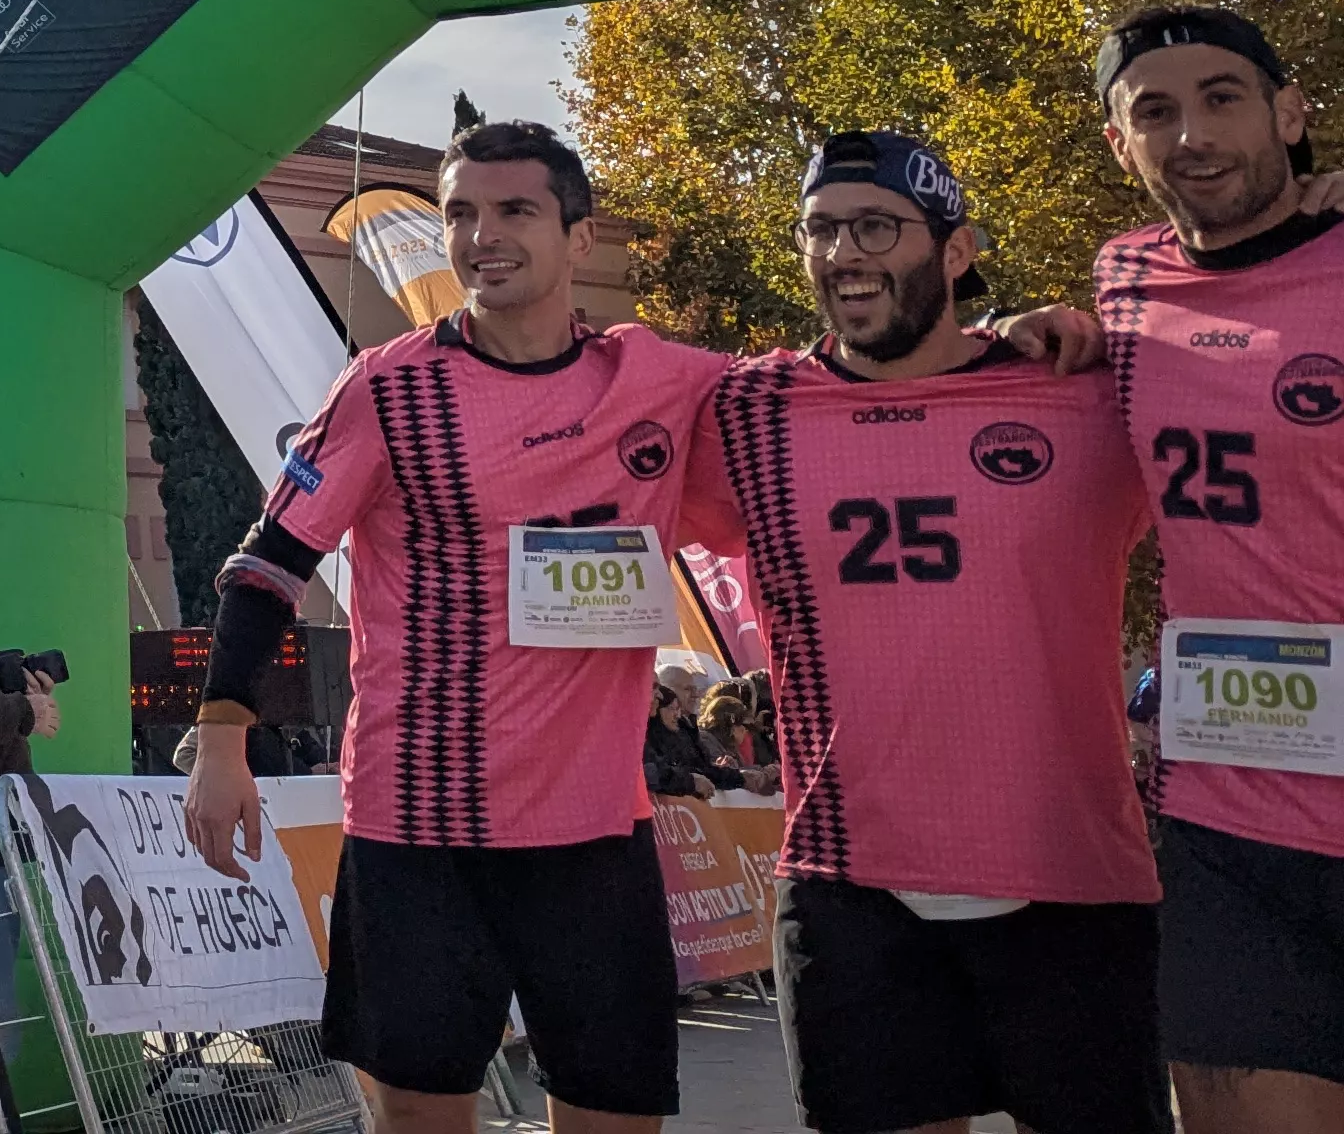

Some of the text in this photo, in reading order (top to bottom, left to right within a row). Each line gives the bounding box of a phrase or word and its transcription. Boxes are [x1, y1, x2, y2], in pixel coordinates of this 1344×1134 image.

[1189, 329, 1253, 350] adidas
[852, 404, 926, 425] adidas
[522, 421, 584, 450] adidas
[1152, 427, 1261, 528] 25
[828, 495, 962, 585] 25
[543, 560, 645, 592] 1091
[570, 594, 631, 606] RAMIRO
[1196, 667, 1317, 711] 1090
[1208, 708, 1308, 728] FERNANDO
[147, 885, 293, 954] DE HUESCA
